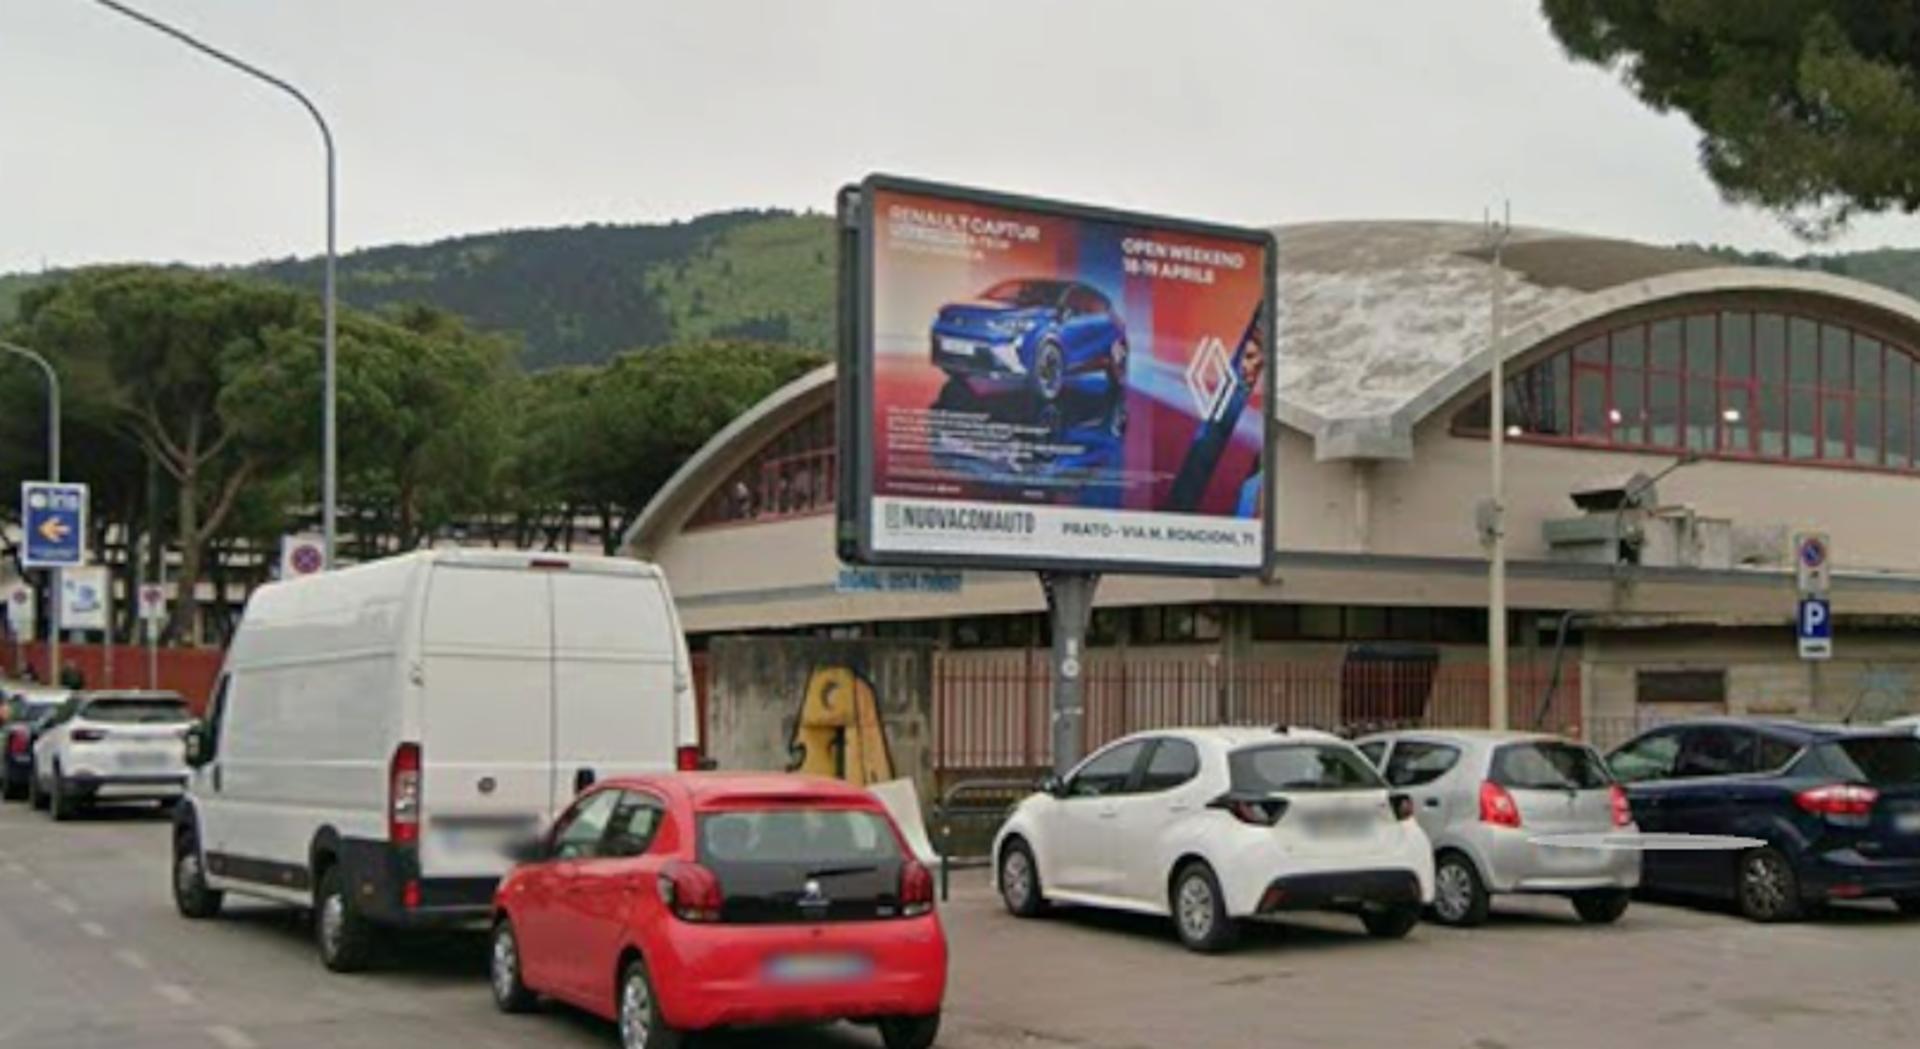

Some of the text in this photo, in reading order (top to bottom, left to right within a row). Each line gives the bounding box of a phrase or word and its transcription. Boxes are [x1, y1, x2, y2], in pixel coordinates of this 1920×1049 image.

[888, 205, 969, 231] RENAULT
[970, 217, 1041, 242] CAPTUR
[1122, 238, 1246, 270] OPEN WEEKEND
[1160, 262, 1216, 285] APRILE
[903, 504, 1036, 534] NUOVACOMAUTO
[1122, 525, 1146, 538] VIA
[1150, 527, 1164, 540] M.
[1803, 601, 1825, 635] P
